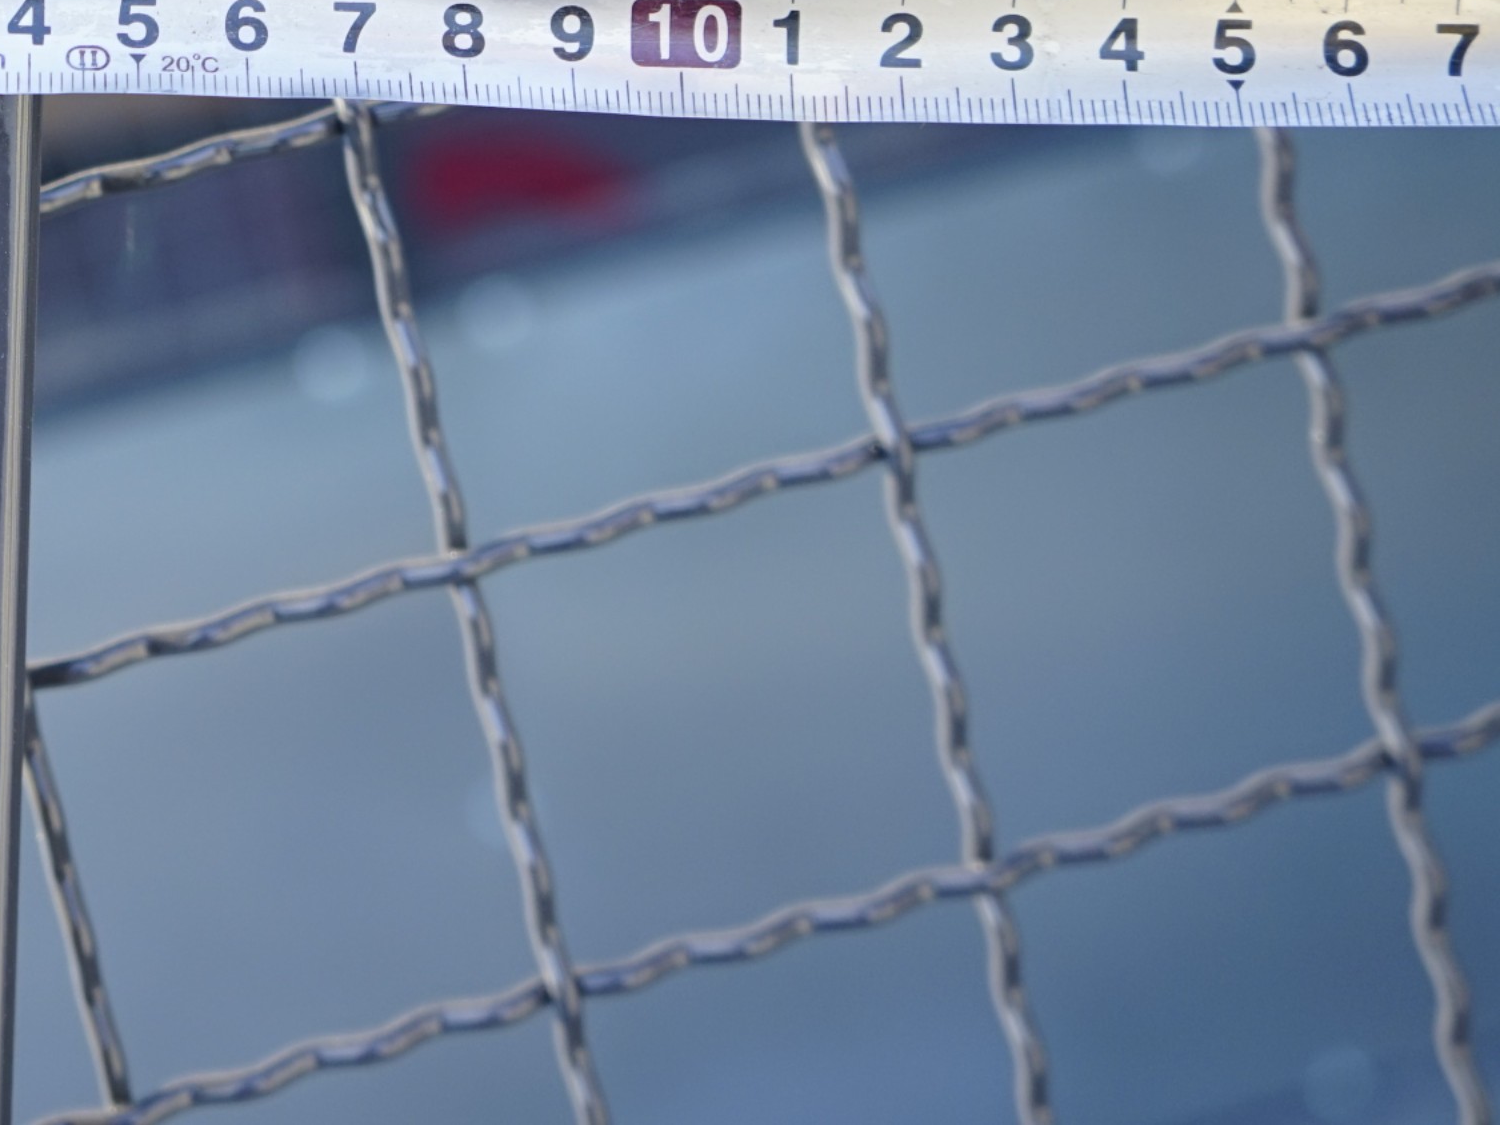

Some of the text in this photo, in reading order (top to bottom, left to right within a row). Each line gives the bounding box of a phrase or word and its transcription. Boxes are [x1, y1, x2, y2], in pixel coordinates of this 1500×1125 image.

[334, 2, 376, 53] 7
[442, 3, 485, 58] 8
[551, 6, 594, 62] 9
[647, 3, 728, 62] 10
[772, 10, 800, 66] 1
[880, 13, 923, 69] 2
[991, 15, 1034, 71] 3
[1100, 18, 1144, 72] 4
[1213, 20, 1255, 75] 5
[1324, 22, 1368, 77] 6
[1436, 24, 1479, 77] 7
